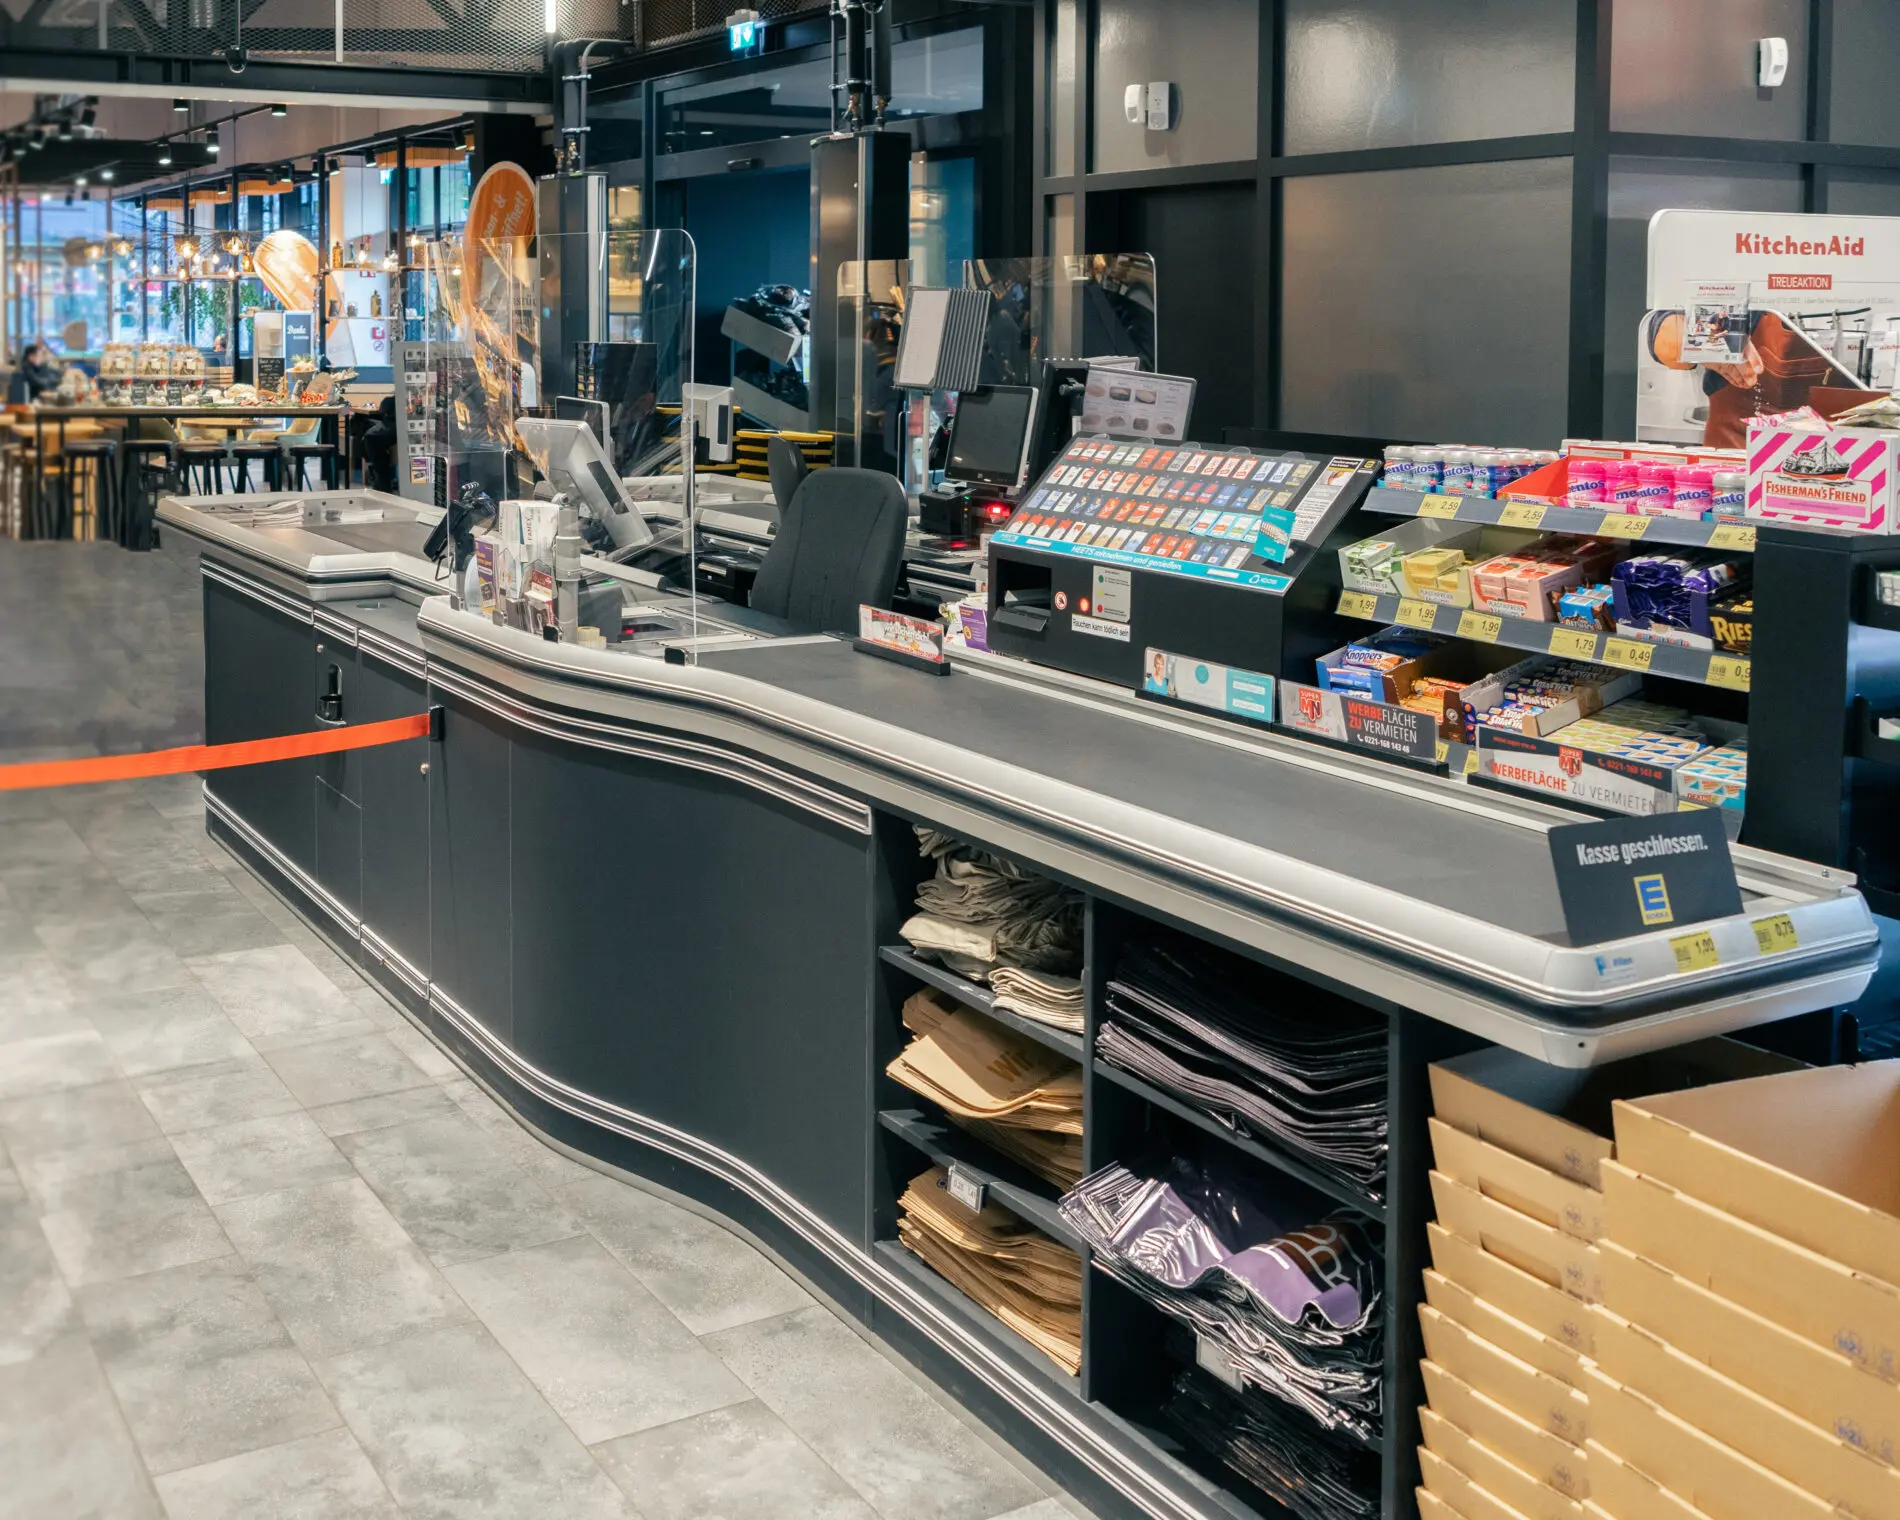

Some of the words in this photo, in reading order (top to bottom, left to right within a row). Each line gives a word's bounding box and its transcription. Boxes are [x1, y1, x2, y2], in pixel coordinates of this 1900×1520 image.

[1735, 233, 1864, 256] KitchenAid
[1771, 276, 1829, 289] TREUEAKTION
[1568, 479, 1605, 493] entos
[1638, 485, 1669, 498] ntos
[1766, 480, 1828, 501] FISHERMAN'S
[1828, 487, 1867, 504] FRIEND
[1713, 492, 1745, 506] ento
[1440, 501, 1459, 511] 2,59
[1522, 510, 1542, 521] 2,59
[1624, 521, 1646, 532] 2,59
[1738, 531, 1756, 542] 2,5
[1359, 599, 1375, 611] 1,99
[1418, 608, 1435, 620] 1,99
[1073, 617, 1092, 629] Rauchen
[1092, 623, 1103, 632] kann
[1103, 625, 1119, 635] tödlich
[1481, 620, 1499, 633] 1,99
[1709, 615, 1752, 646] RIES
[1575, 638, 1594, 651] 1,79
[1344, 649, 1383, 662] Knoppers
[1629, 649, 1651, 662] 0,49
[1735, 665, 1751, 678] 0,9
[1300, 690, 1321, 700] SUPER
[1347, 701, 1417, 730] WERBEFLÄCHE
[1349, 716, 1363, 730] ZU
[1363, 719, 1418, 744] VERMIETEN
[1561, 748, 1581, 758] SUPER
[1491, 761, 1567, 793] WERBEFLÄCHE
[1571, 781, 1585, 797] ZU
[1590, 785, 1657, 814] VERMIETEN
[1576, 843, 1620, 866] Kasse
[1621, 834, 1709, 865] geschlossen.
[1639, 879, 1666, 912] E
[1774, 921, 1796, 938] 0,79
